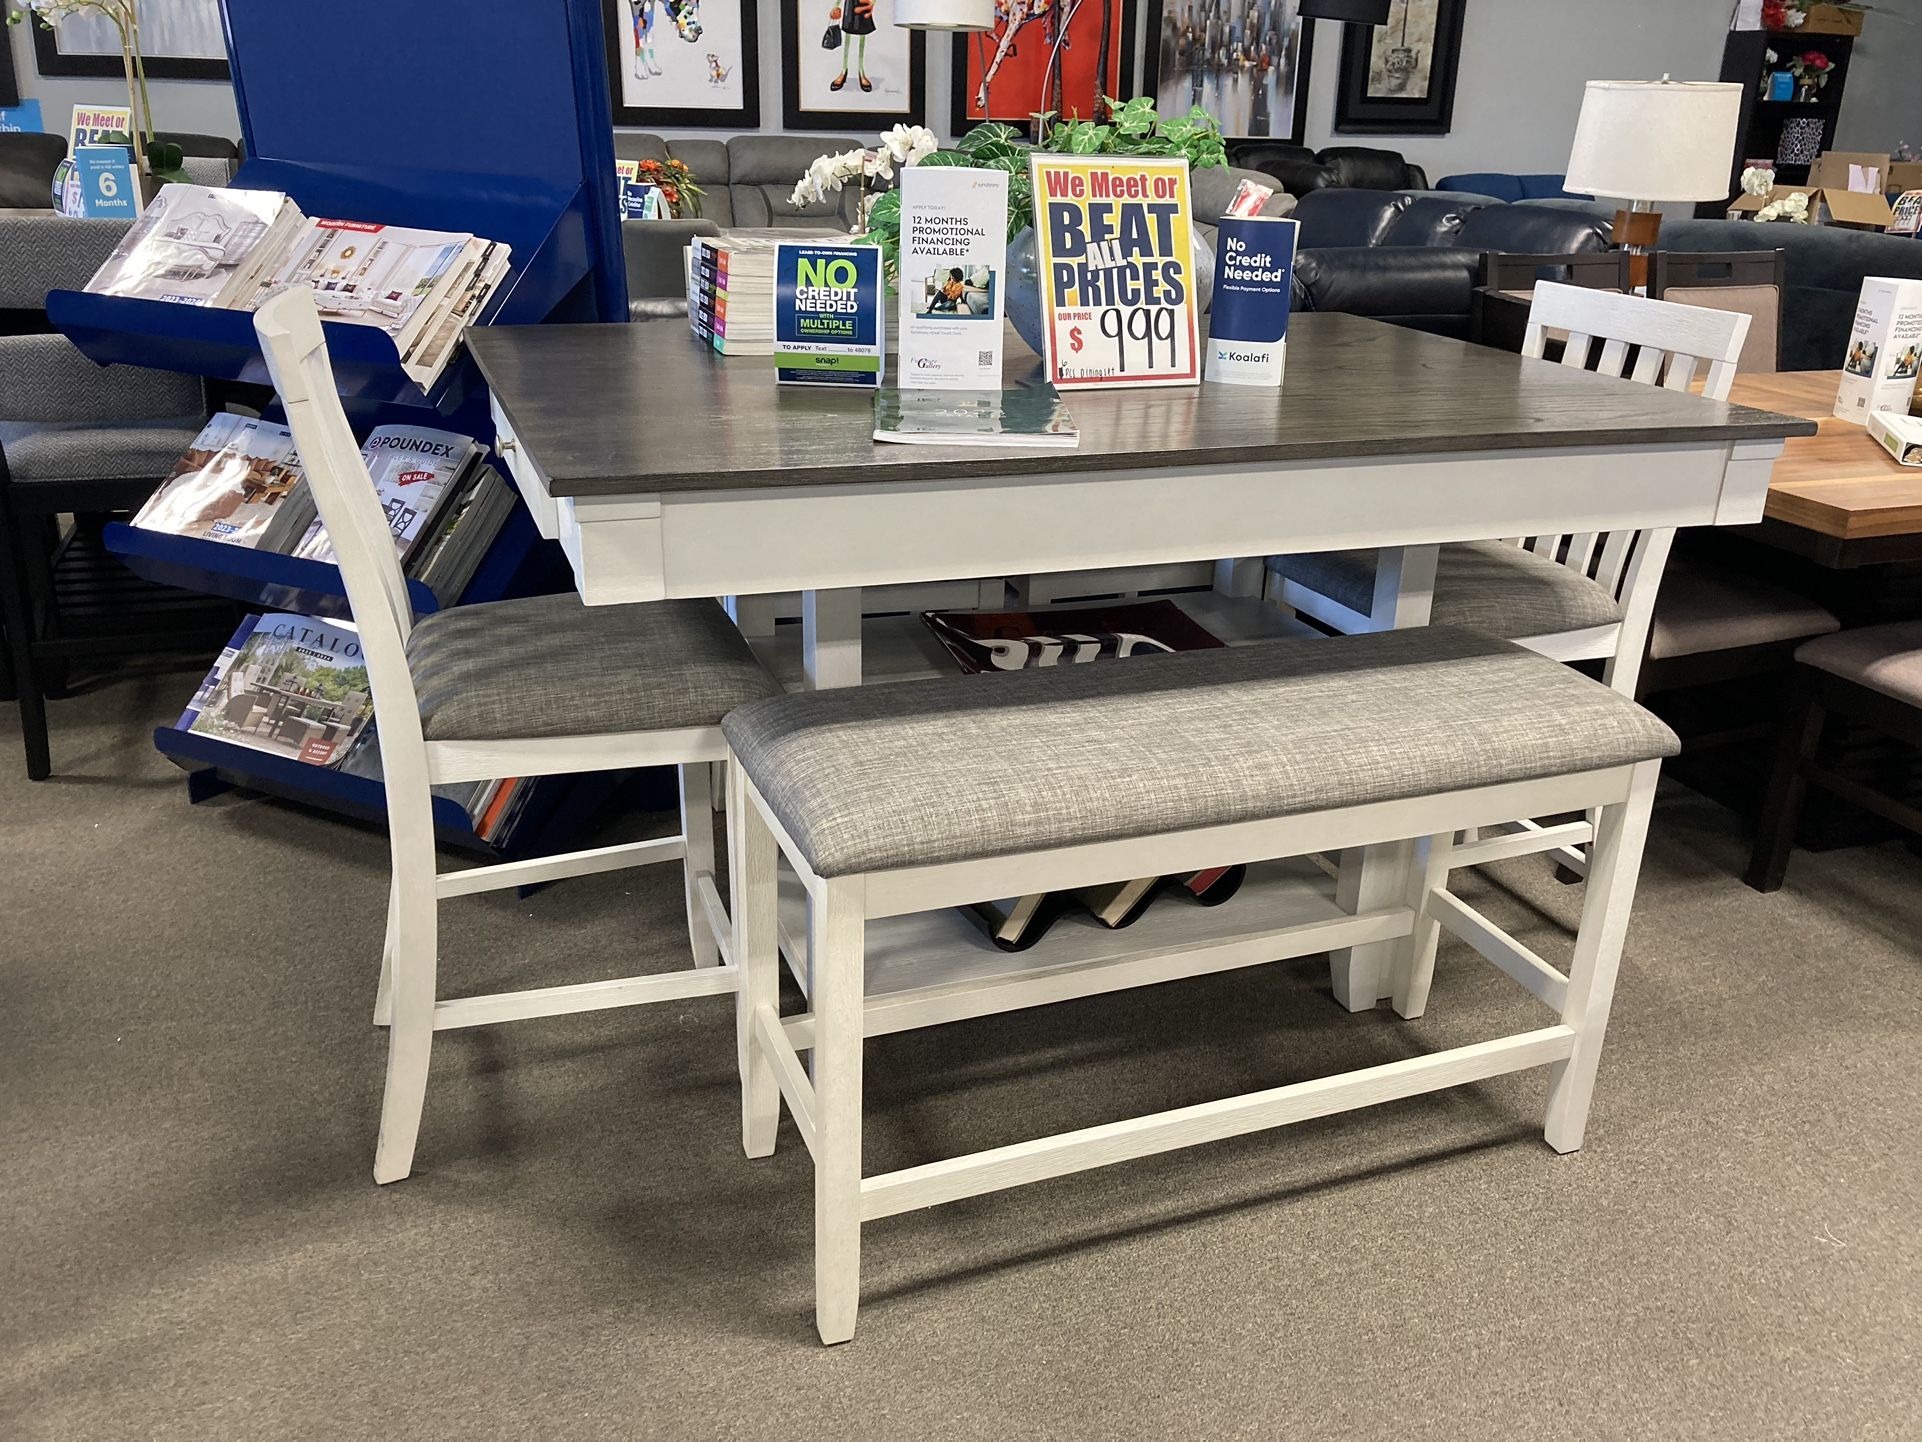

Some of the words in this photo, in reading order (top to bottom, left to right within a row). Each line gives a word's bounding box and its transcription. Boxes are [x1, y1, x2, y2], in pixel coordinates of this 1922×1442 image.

[77, 112, 90, 126] We
[92, 113, 114, 127] Meet
[115, 115, 126, 128] or
[99, 172, 117, 197] 6
[1045, 171, 1085, 198] We
[1090, 172, 1149, 199] Meet
[1154, 177, 1178, 199] or
[95, 199, 128, 207] Months
[912, 216, 922, 224] 12
[924, 216, 969, 226] MONTHS
[912, 226, 986, 236] PROMOTIONAL
[1048, 202, 1179, 258] BEAT
[912, 236, 970, 246] FINANCING
[1227, 237, 1246, 251] No
[1086, 239, 1128, 271] ALL
[1225, 252, 1271, 267] Credit
[797, 257, 858, 289] NO
[1053, 260, 1185, 307] PRICES
[795, 286, 858, 301] CREDIT
[800, 318, 853, 329] MULTIPLE
[1058, 313, 1073, 321] OUR
[1073, 312, 1092, 321] PRICE
[1069, 326, 1084, 353] $
[1100, 307, 1176, 372] 999
[815, 357, 839, 365] snap!
[1229, 352, 1270, 363] Koalafi
[380, 437, 454, 458] POUNDEX
[272, 623, 365, 660] CATALO
